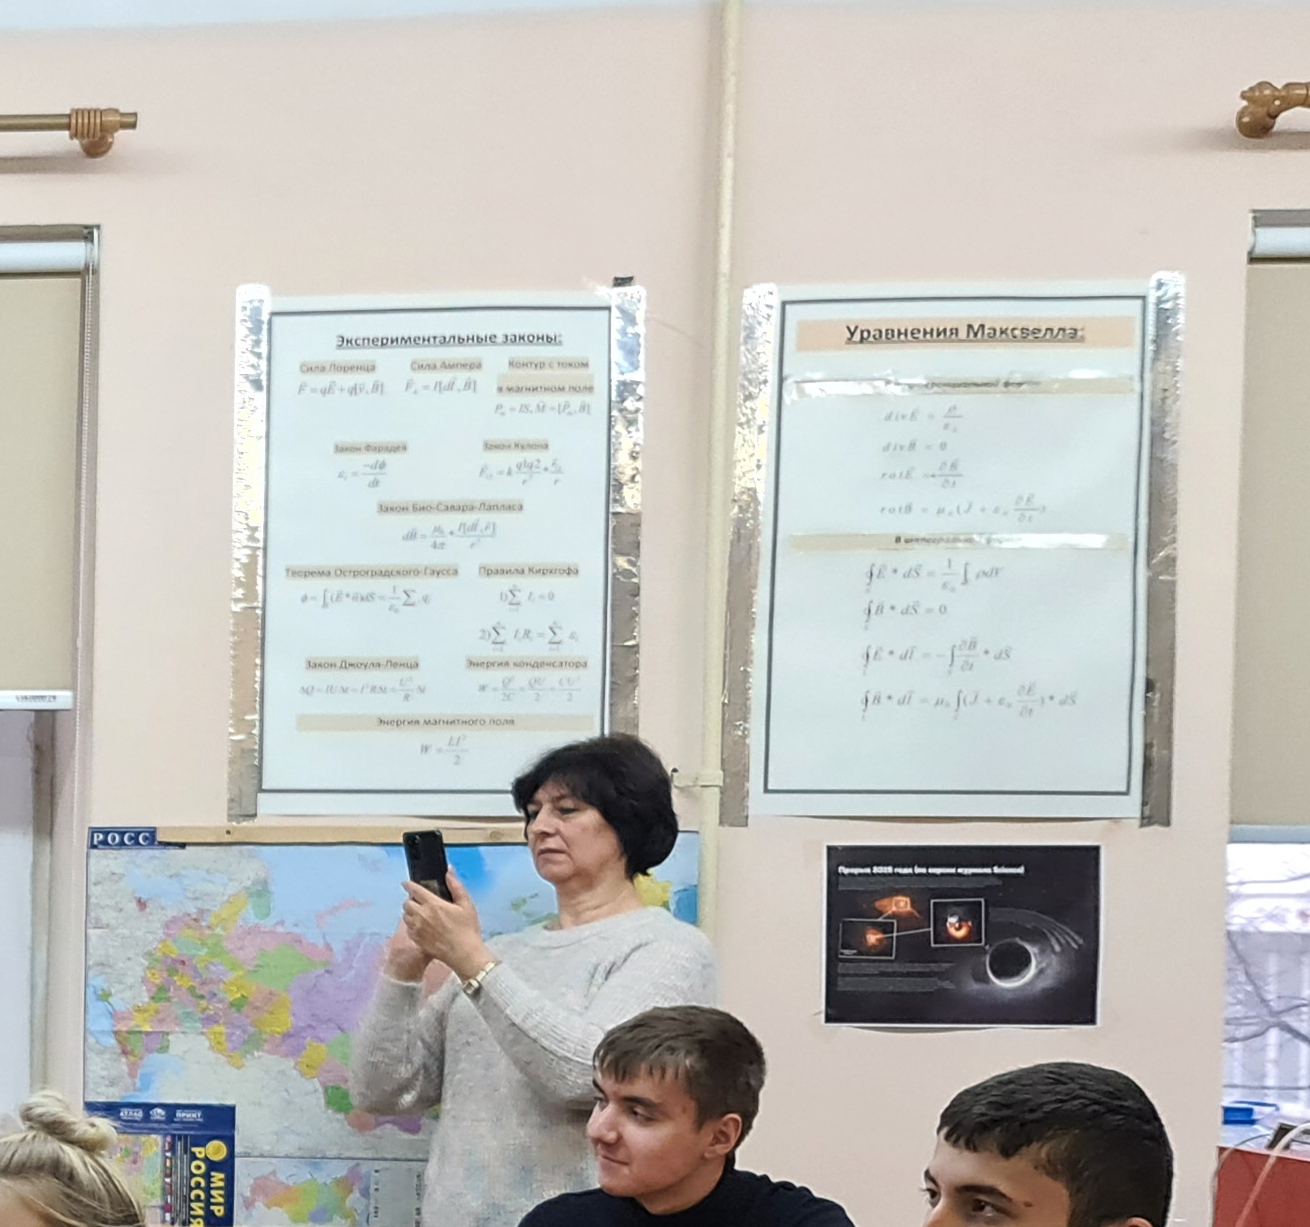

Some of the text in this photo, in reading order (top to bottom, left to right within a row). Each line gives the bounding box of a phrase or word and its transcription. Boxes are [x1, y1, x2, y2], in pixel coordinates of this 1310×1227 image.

[335, 331, 563, 349] Экспериментальные законы:
[846, 322, 1085, 345] Уравнения Максвелла:
[300, 361, 376, 374] Сила Лоренца
[410, 360, 482, 372] Сила Ампера
[506, 384, 566, 394] магнитном
[92, 831, 151, 846] РОСС
[210, 1171, 225, 1217] МИР
